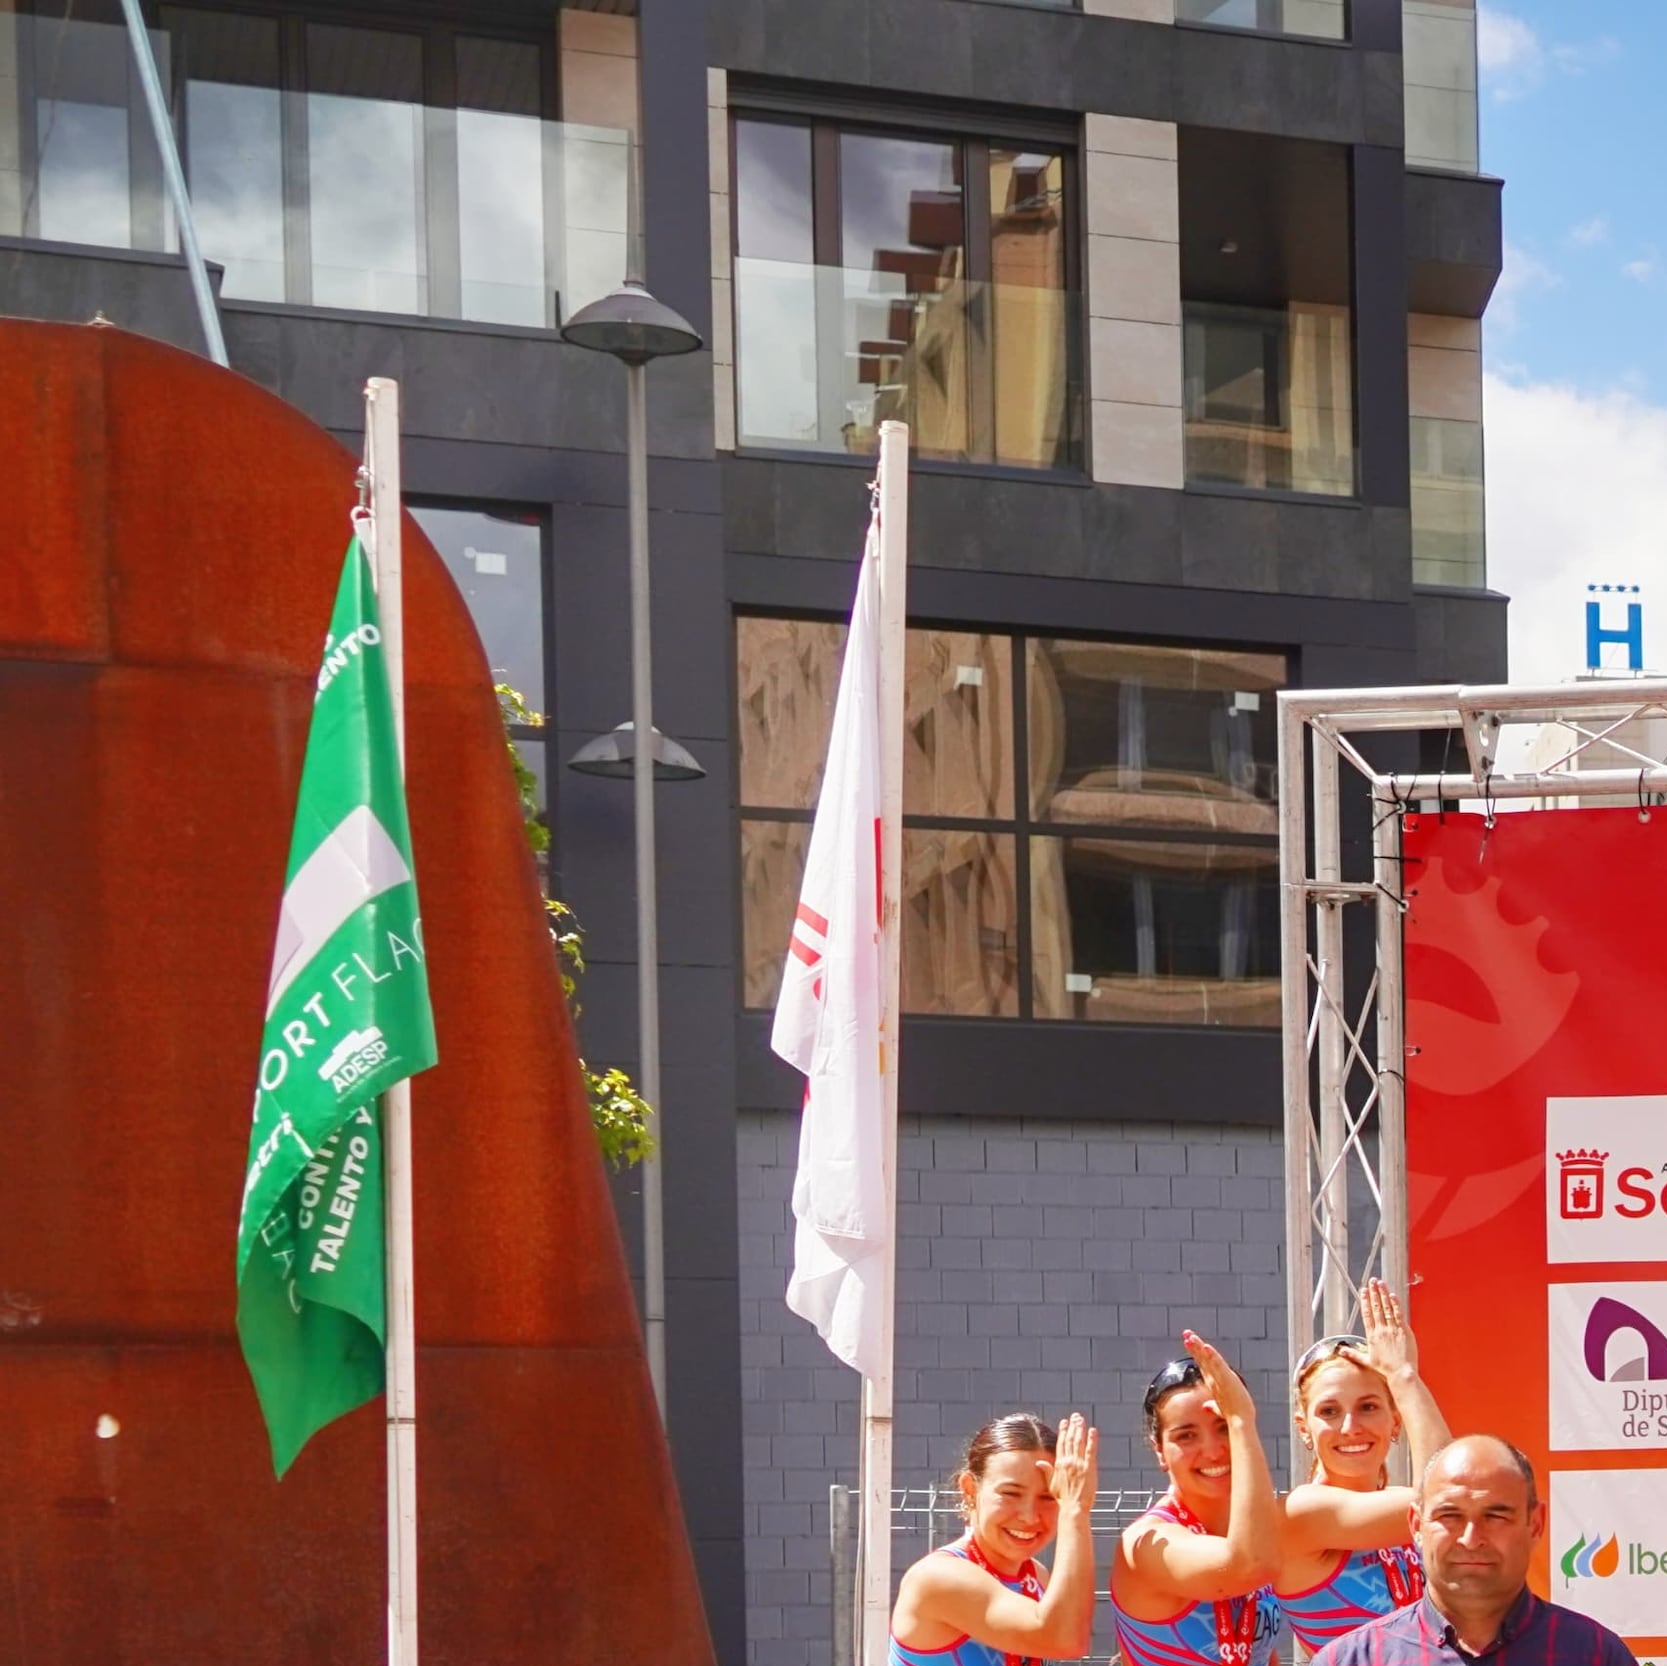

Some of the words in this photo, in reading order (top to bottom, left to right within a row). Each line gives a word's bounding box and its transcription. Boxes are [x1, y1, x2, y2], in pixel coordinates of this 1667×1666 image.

[1586, 602, 1642, 671] H
[331, 1039, 391, 1095] ADESP
[310, 1136, 369, 1274] TALENTO
[1622, 1415, 1650, 1438] de
